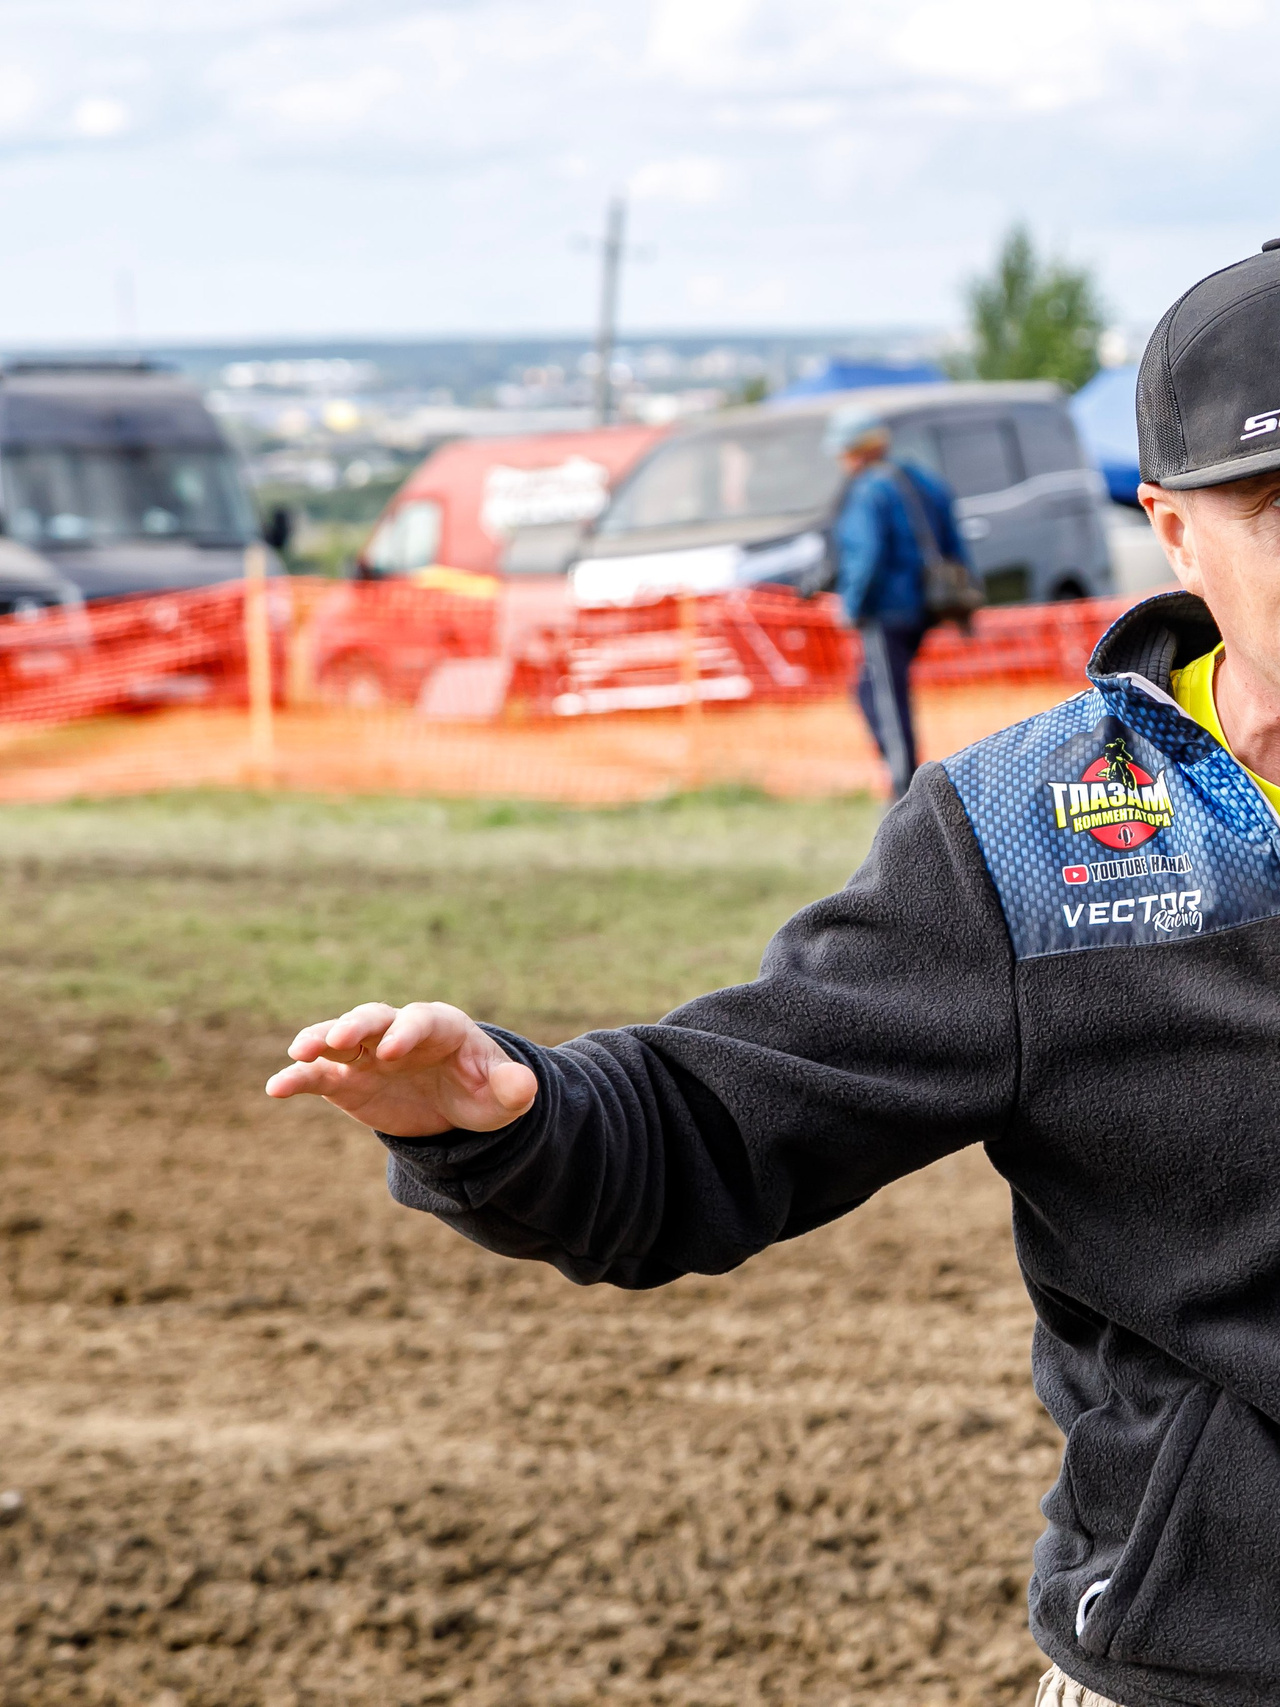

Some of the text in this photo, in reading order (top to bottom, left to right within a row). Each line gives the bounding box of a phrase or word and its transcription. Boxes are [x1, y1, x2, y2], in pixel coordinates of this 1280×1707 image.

[1073, 807, 1172, 833] КОММЕНТАТОРА
[1091, 857, 1148, 881] YOUTUBE
[1062, 889, 1202, 928] VECTOR
[1152, 908, 1203, 932] Racing
